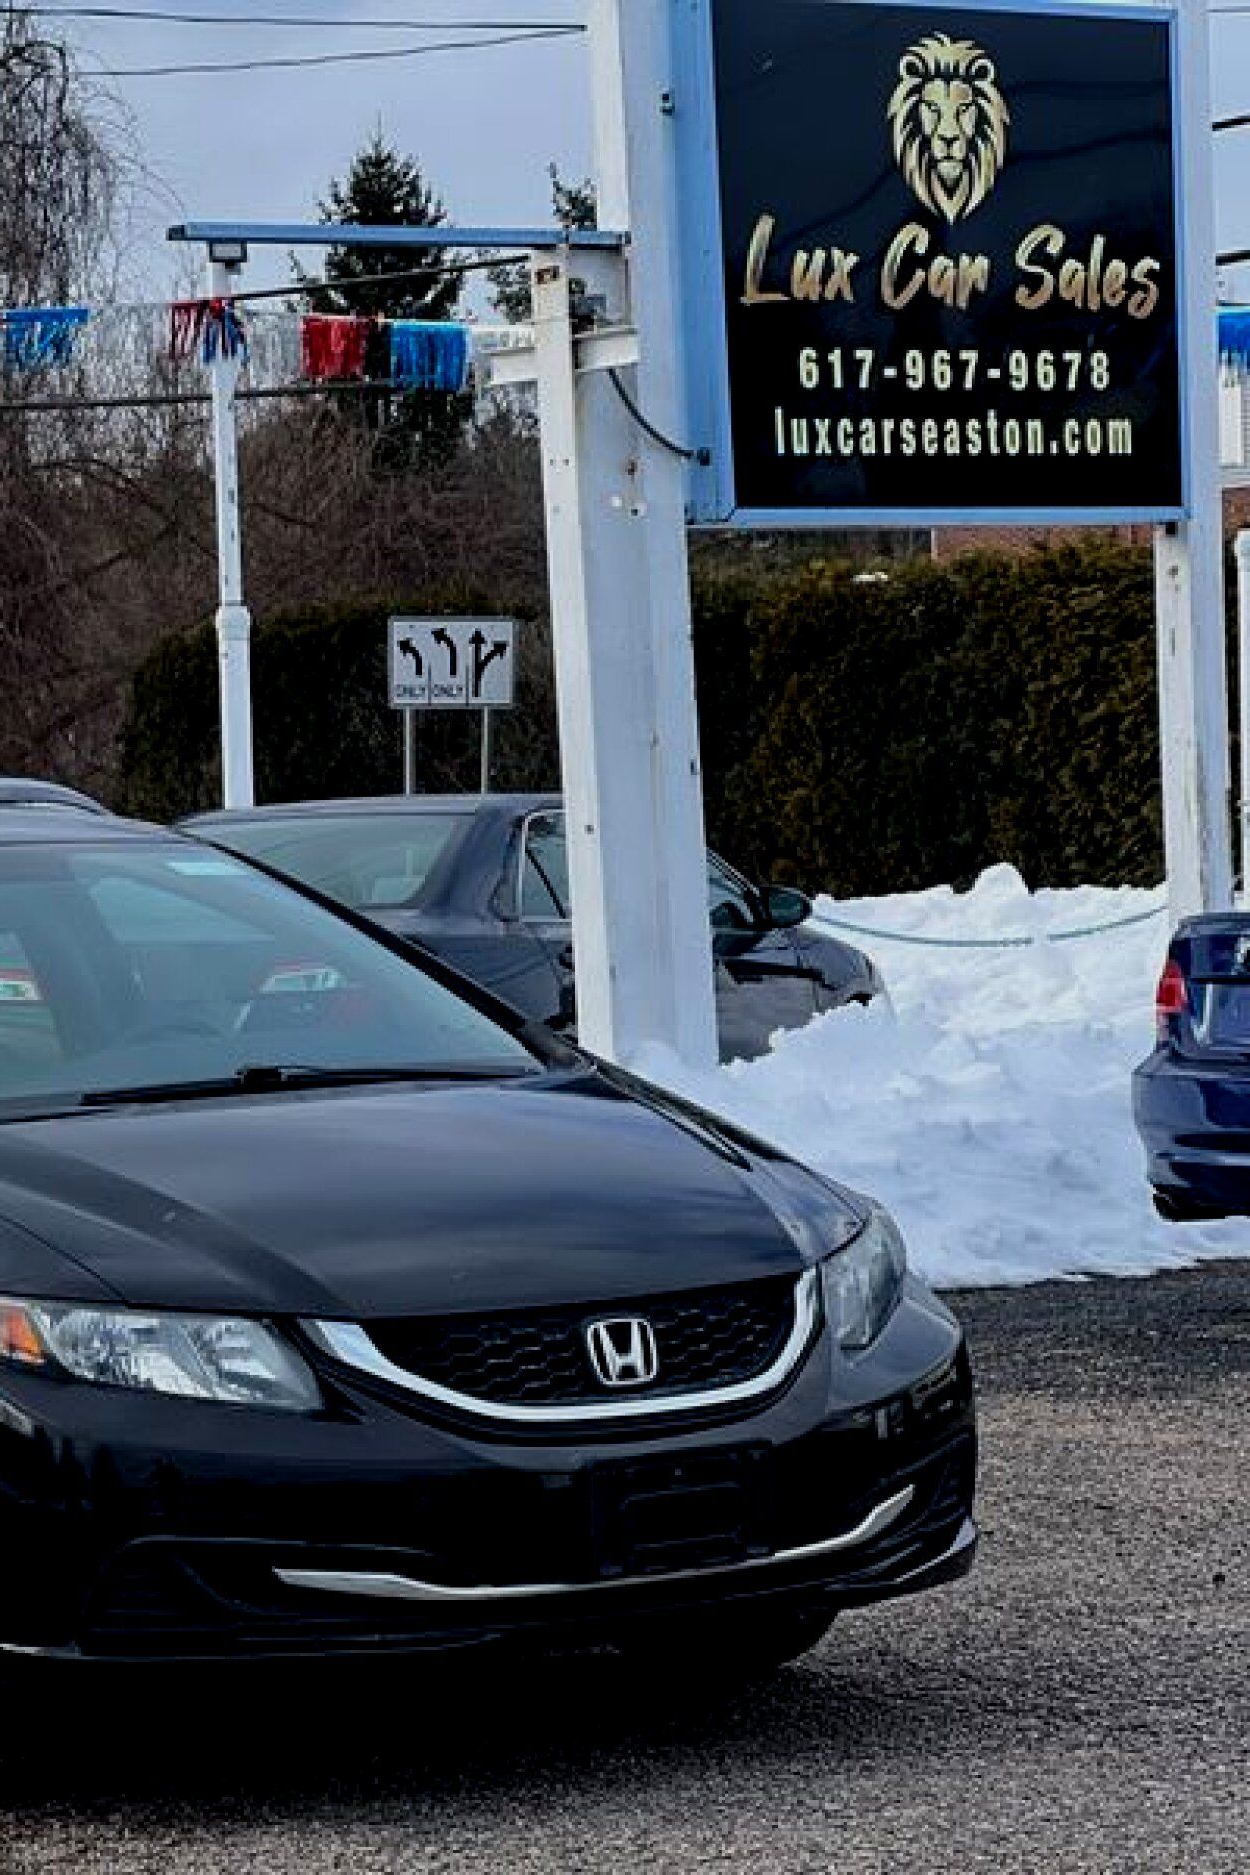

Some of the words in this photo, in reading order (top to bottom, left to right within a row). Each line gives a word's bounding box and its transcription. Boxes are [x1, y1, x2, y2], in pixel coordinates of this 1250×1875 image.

[740, 214, 860, 306] Lux
[881, 221, 992, 310] Car
[1014, 224, 1161, 320] Sales
[798, 347, 1111, 391] 617-967-9678
[774, 406, 1133, 456] luxcarseaston.com
